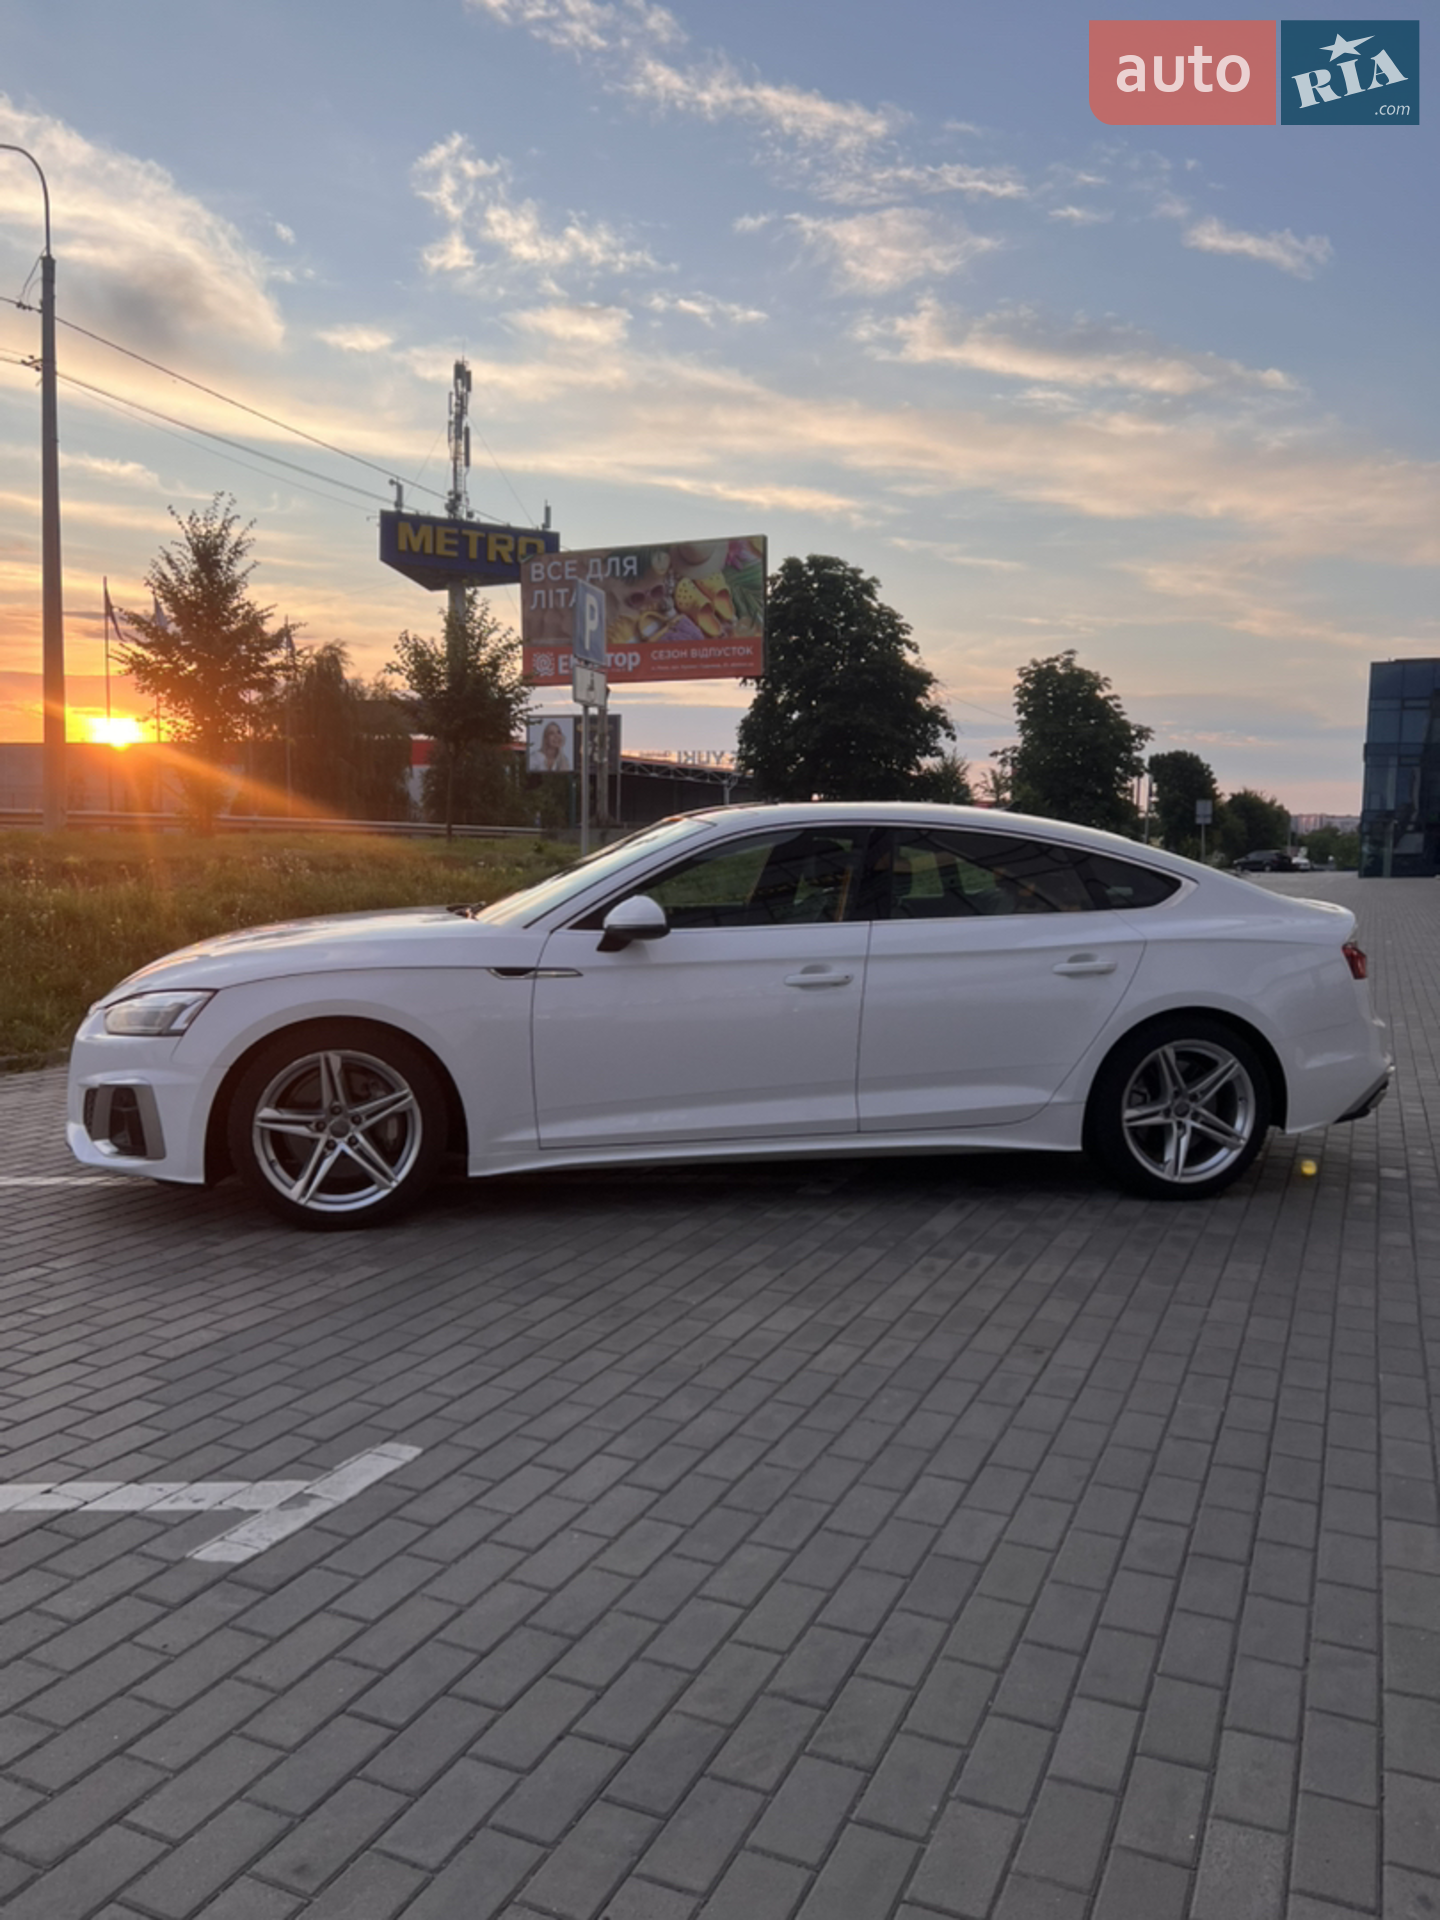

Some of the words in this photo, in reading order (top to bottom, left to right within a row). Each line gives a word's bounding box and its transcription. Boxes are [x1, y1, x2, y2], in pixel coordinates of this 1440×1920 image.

[397, 521, 546, 564] METRO
[530, 560, 578, 582] ВСЕ
[586, 555, 638, 583] ДЛЯ
[584, 593, 599, 651] P
[650, 649, 688, 661] СЕЗОН
[690, 645, 754, 659] ВІДПУСТОК
